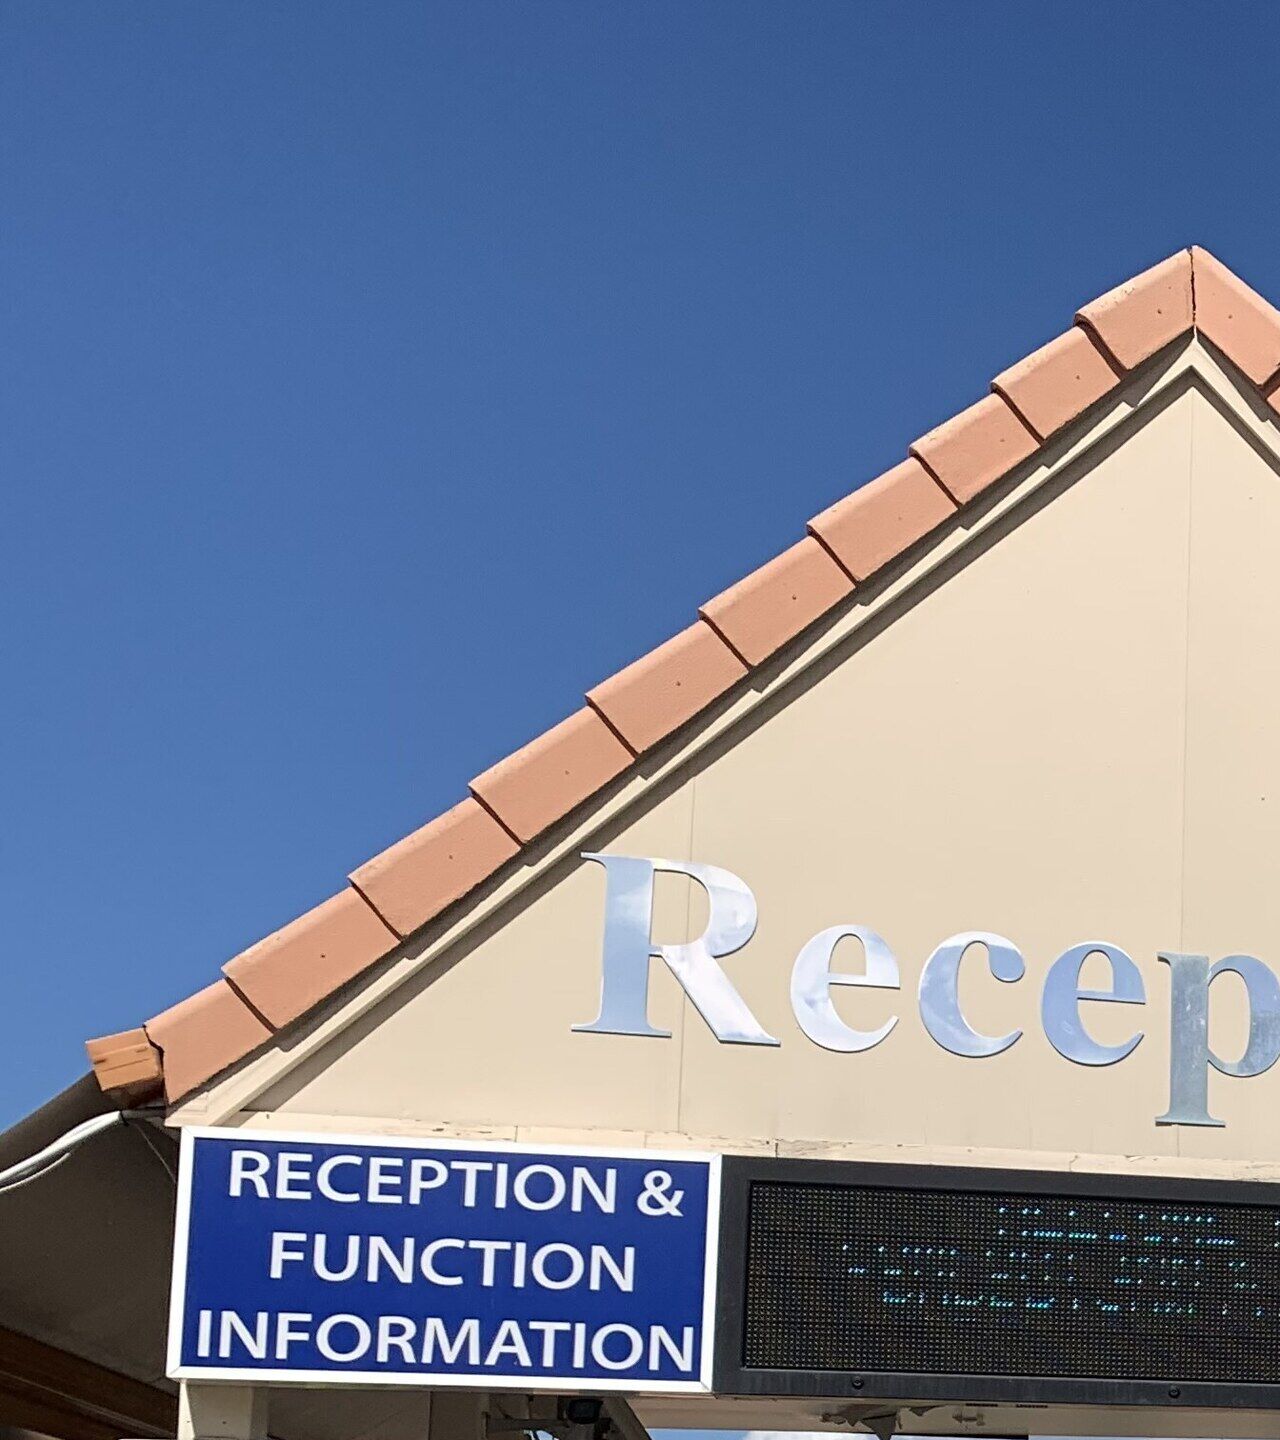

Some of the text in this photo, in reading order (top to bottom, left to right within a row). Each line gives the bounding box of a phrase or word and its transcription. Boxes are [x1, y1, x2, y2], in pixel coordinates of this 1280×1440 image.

[228, 1150, 684, 1217] RECEPTION &
[270, 1232, 634, 1292] FUNCTION
[197, 1310, 693, 1372] INFORMATION
